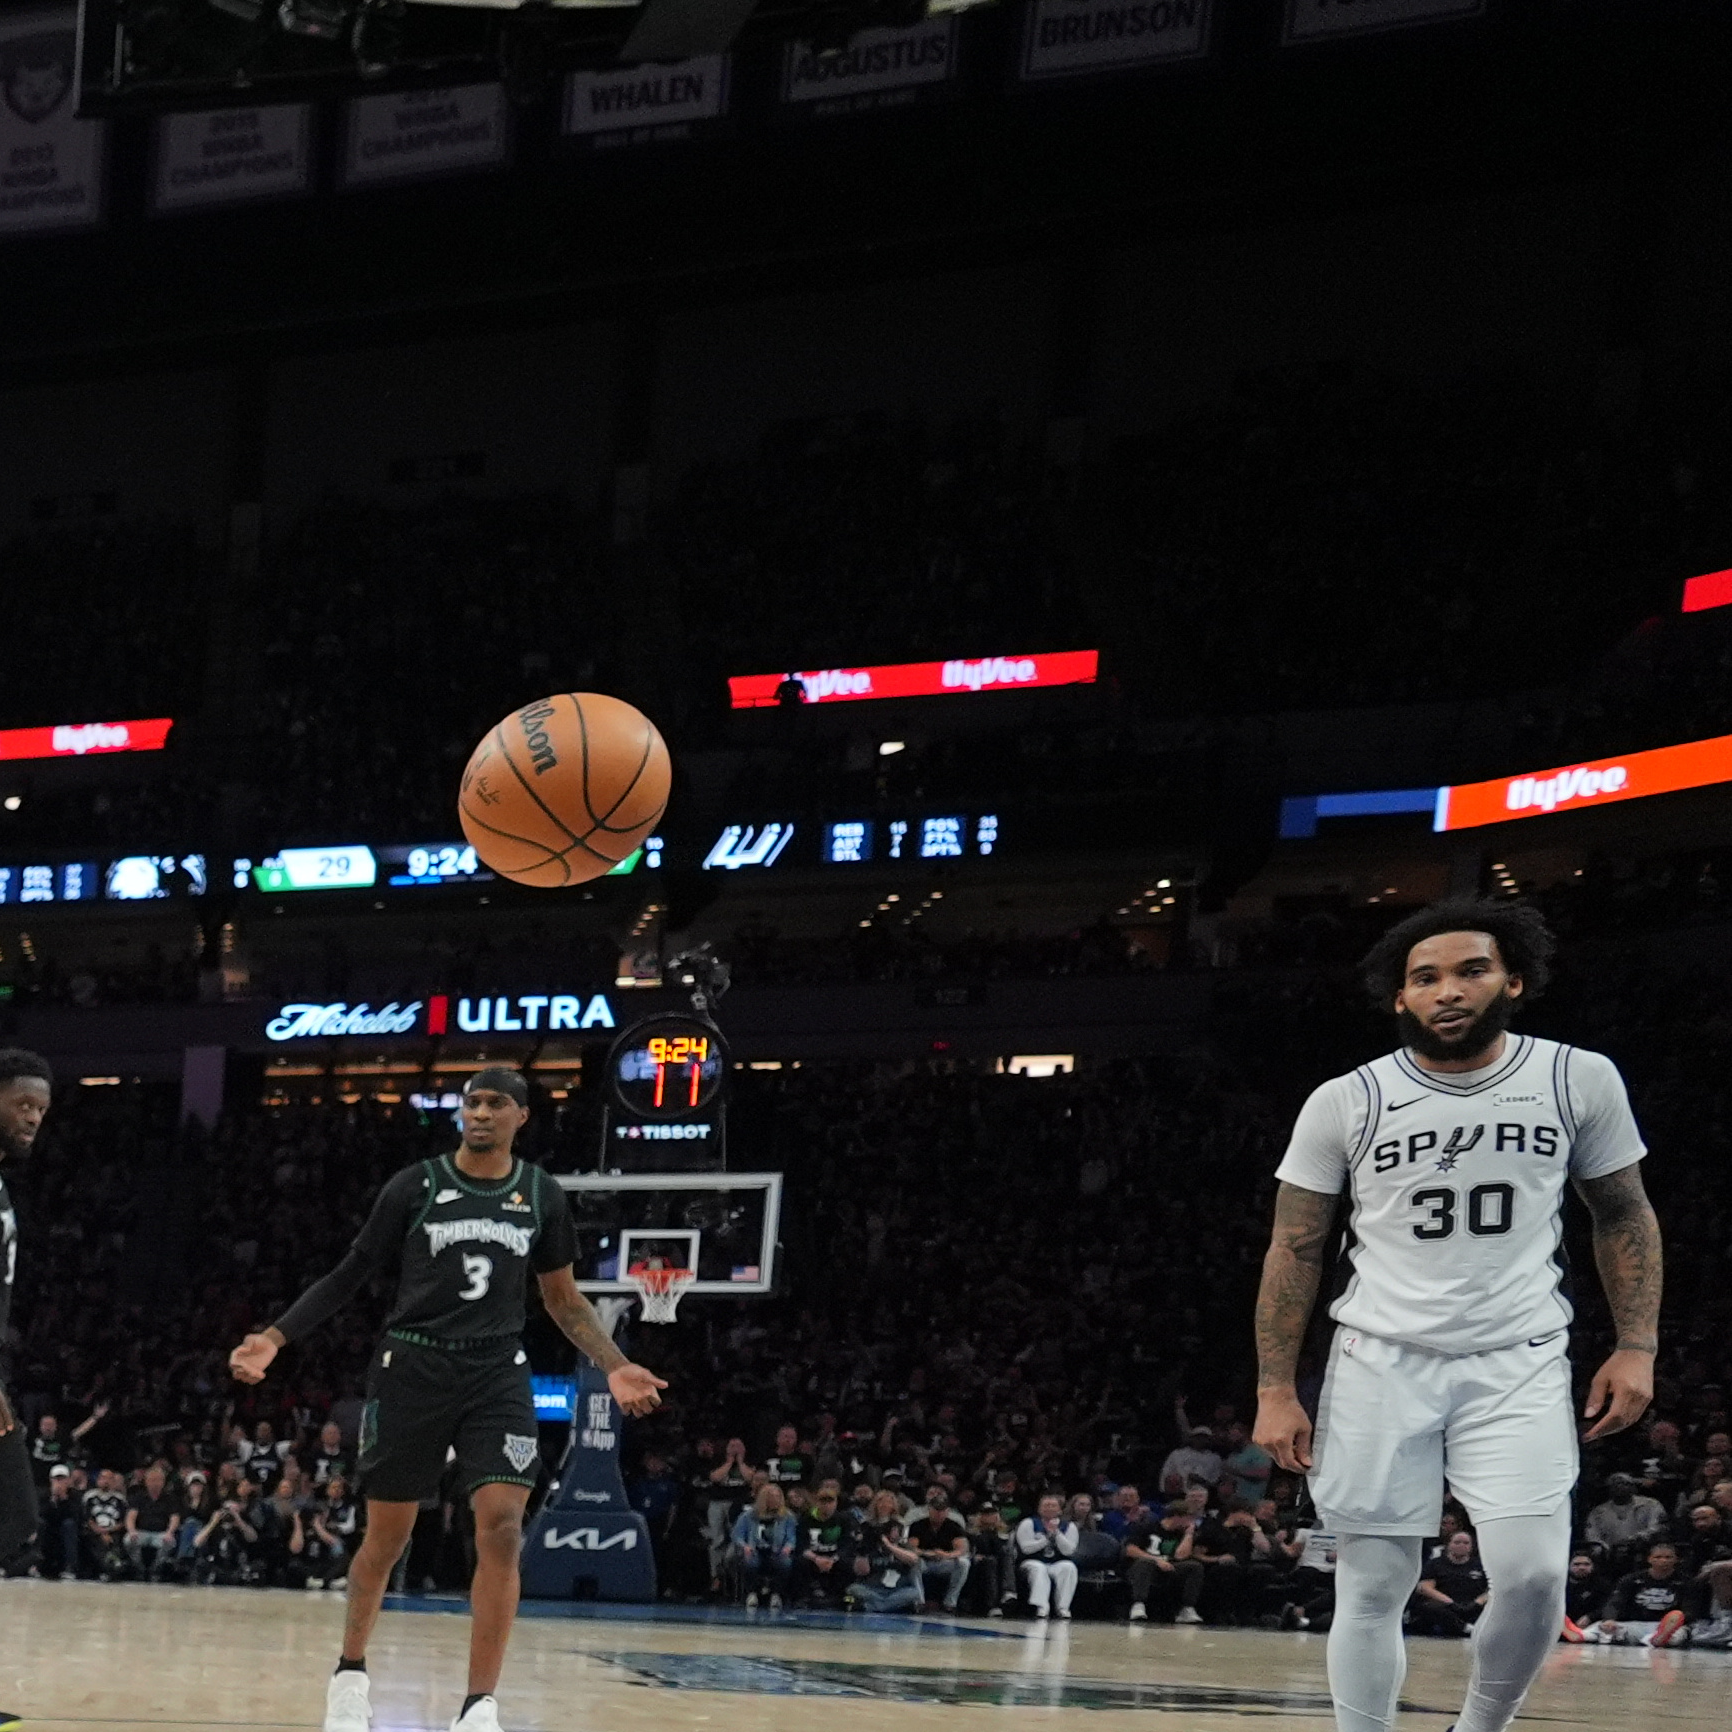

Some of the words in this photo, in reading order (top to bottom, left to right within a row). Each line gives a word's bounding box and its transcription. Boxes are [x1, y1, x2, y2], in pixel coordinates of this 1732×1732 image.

[591, 73, 703, 113] WHALEN
[783, 670, 872, 702] yVee
[942, 657, 1037, 690] HyVee
[1506, 767, 1627, 811] HyVee
[319, 856, 351, 878] 29
[408, 847, 478, 877] 9:24
[265, 1001, 424, 1042] Michelob
[457, 995, 616, 1032] ULTRA
[648, 1037, 708, 1063] 9:24
[653, 1063, 701, 1107] 11
[641, 1124, 711, 1140] TISSOT
[1374, 1122, 1559, 1174] SPURS
[1409, 1180, 1516, 1243] 30
[423, 1217, 536, 1258] TIMBERWOLVES
[458, 1251, 494, 1302] 3
[588, 1392, 612, 1413] GET
[589, 1412, 612, 1430] THE
[592, 1429, 616, 1451] App
